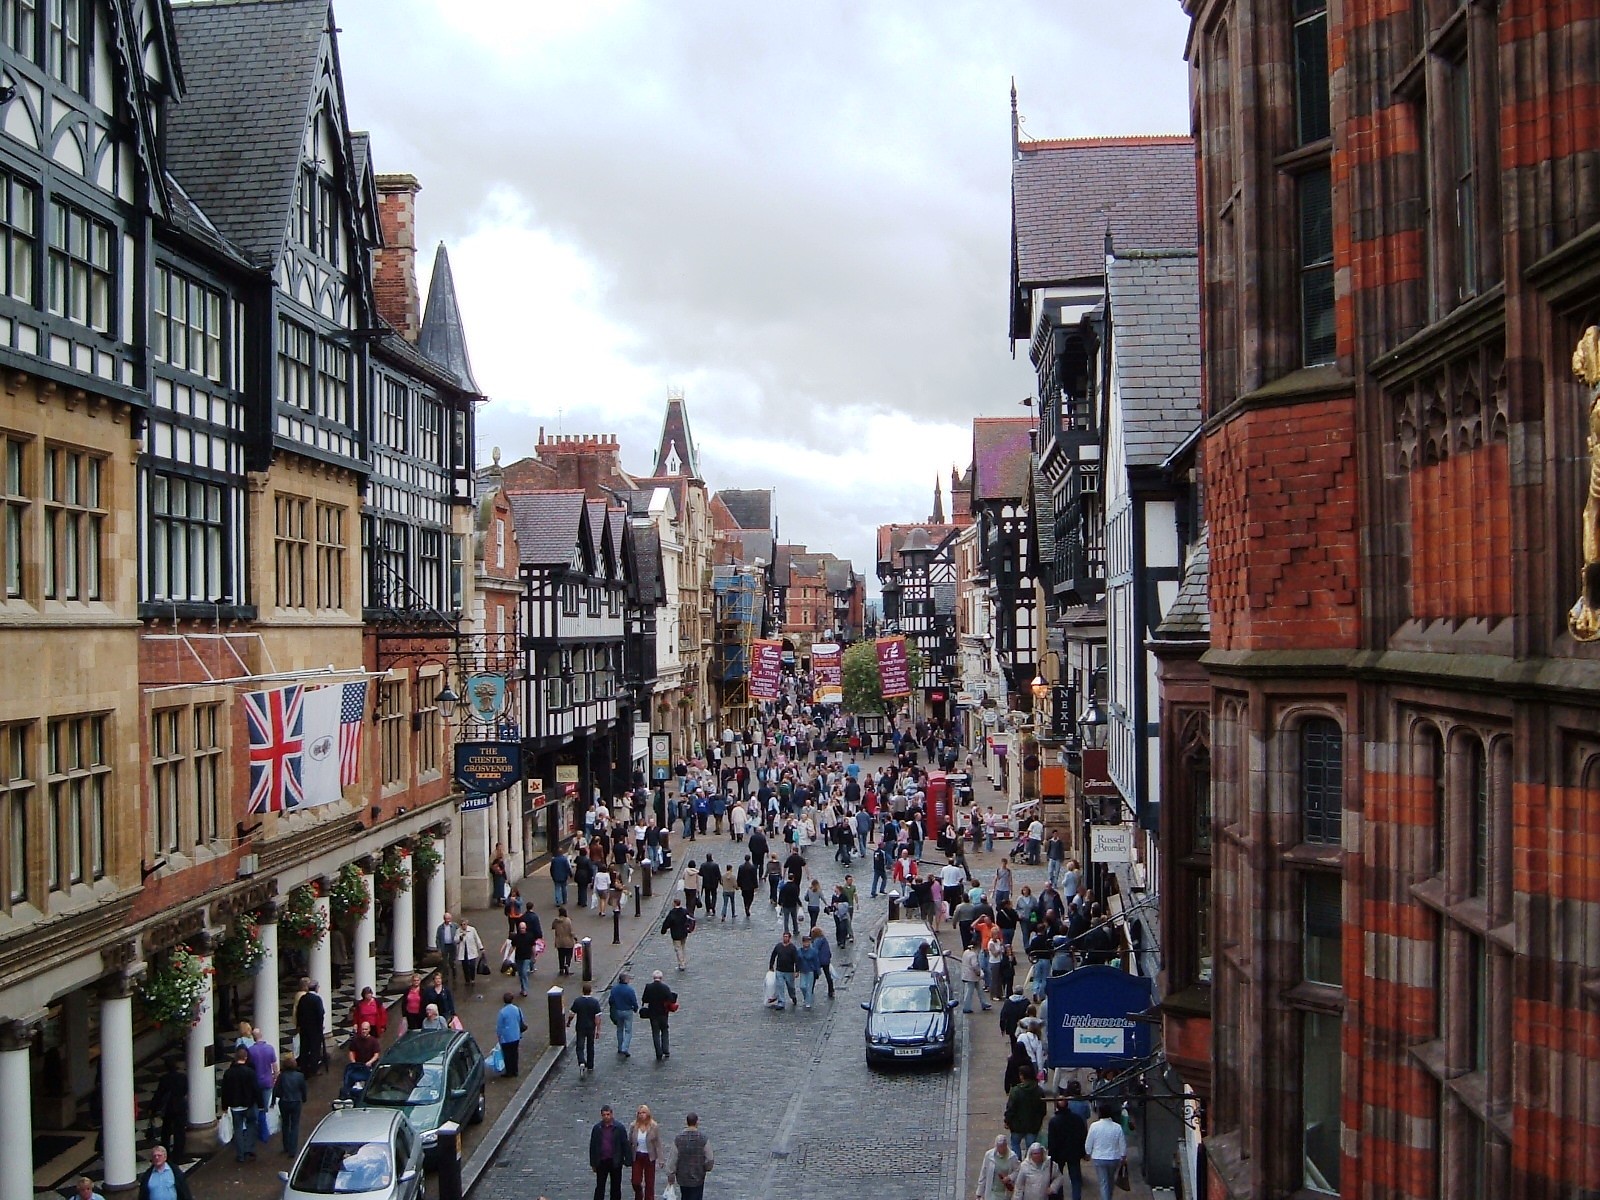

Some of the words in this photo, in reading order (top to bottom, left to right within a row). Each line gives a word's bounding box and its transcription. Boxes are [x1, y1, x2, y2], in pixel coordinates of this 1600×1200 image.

[1060, 689, 1068, 731] NEXT
[1097, 834, 1125, 844] Russell
[1098, 842, 1127, 854] Bromley
[1080, 1034, 1118, 1047] index
